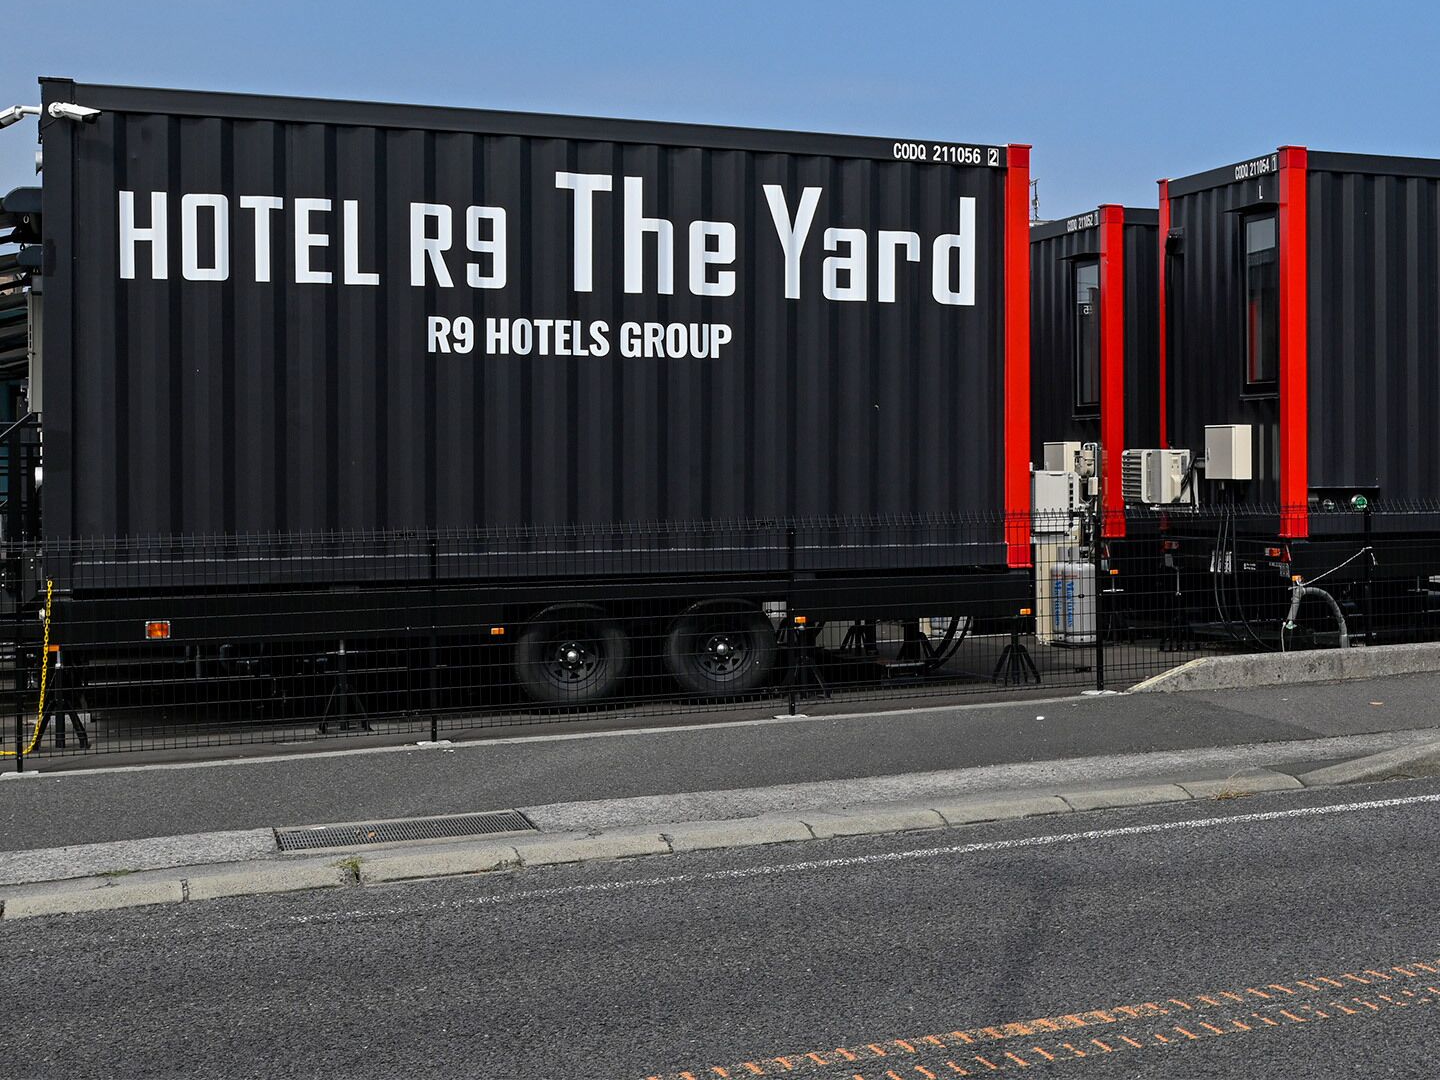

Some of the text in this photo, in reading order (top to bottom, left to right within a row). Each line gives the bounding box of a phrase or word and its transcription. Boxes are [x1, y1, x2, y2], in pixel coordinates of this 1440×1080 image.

[894, 143, 999, 166] CODQ 211056 2
[1250, 158, 1270, 177] 211054
[1258, 185, 1264, 200] L
[119, 172, 976, 306] HOTEL R9 The Yard
[429, 316, 732, 359] R9 HOTELS GROUP
